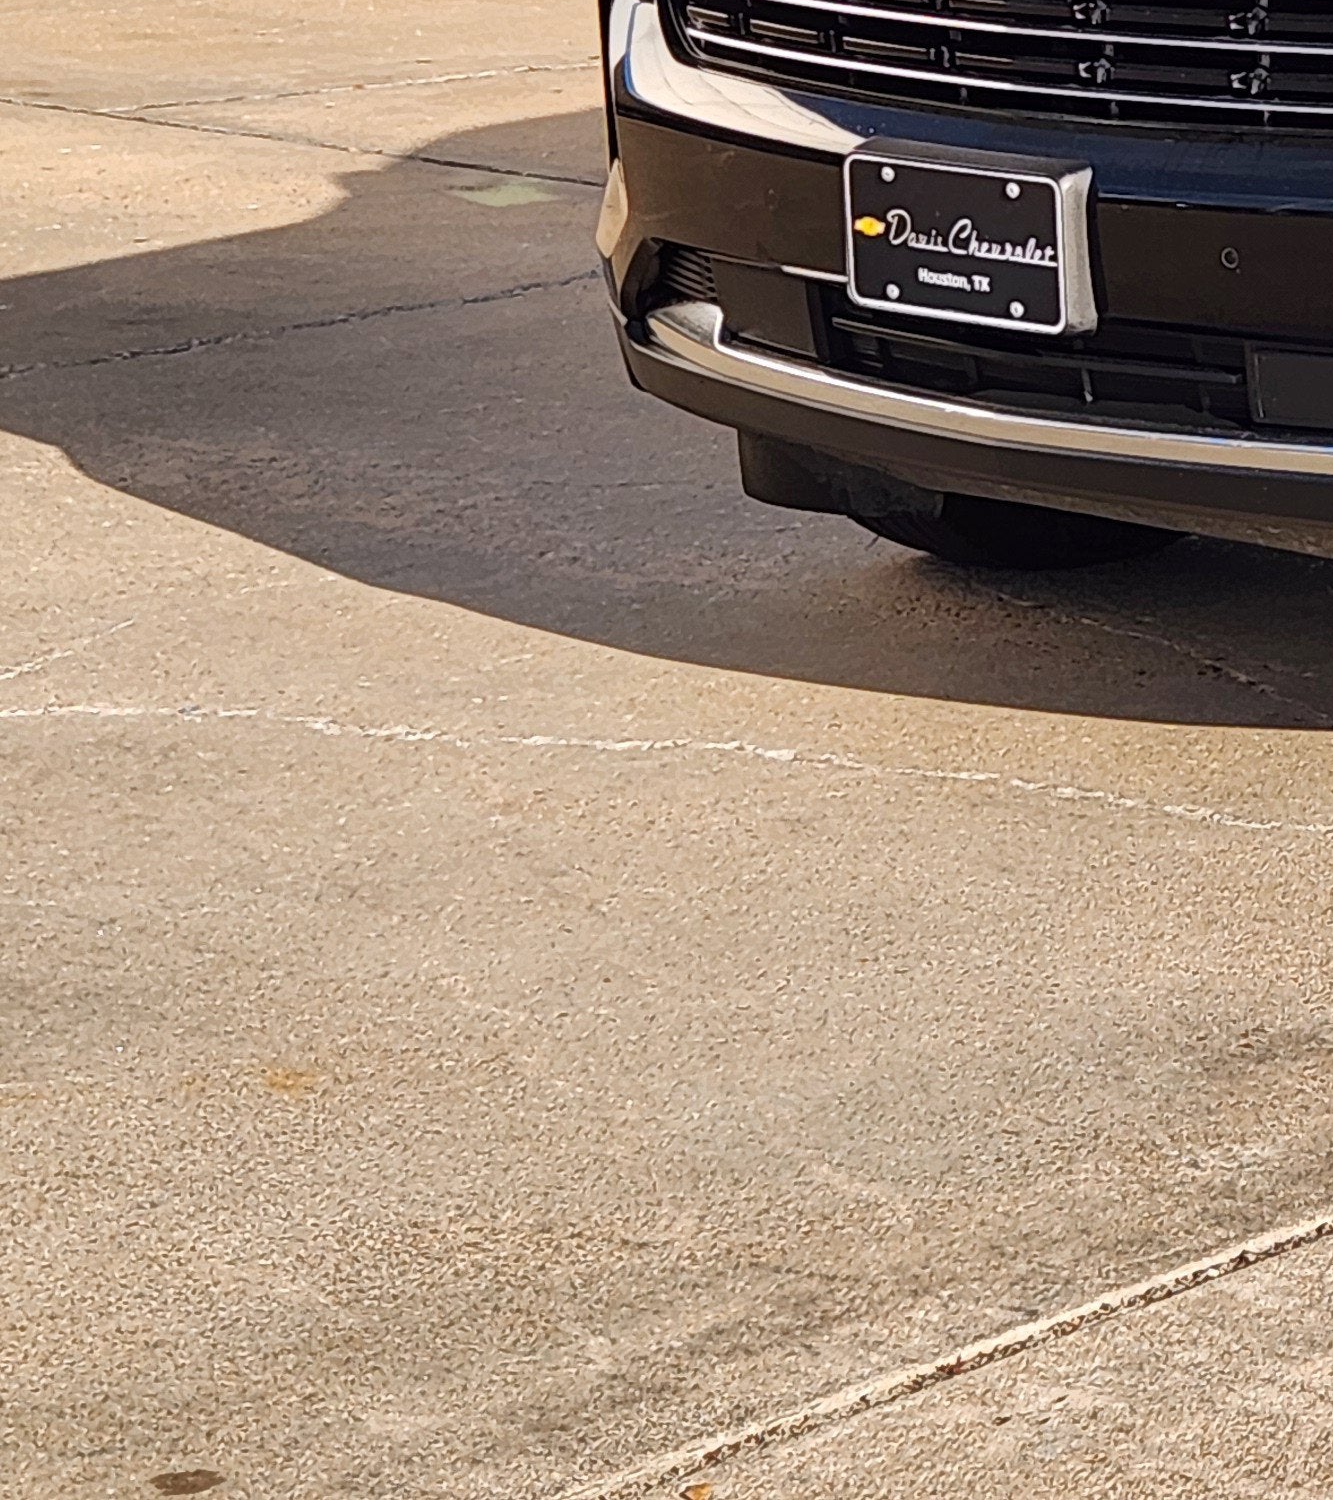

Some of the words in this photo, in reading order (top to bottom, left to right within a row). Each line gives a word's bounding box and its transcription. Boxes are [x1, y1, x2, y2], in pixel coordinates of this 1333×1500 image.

[886, 209, 949, 253] Davis
[949, 218, 1058, 267] Chevrolet
[917, 267, 971, 292] Houston,
[971, 274, 991, 293] TX
